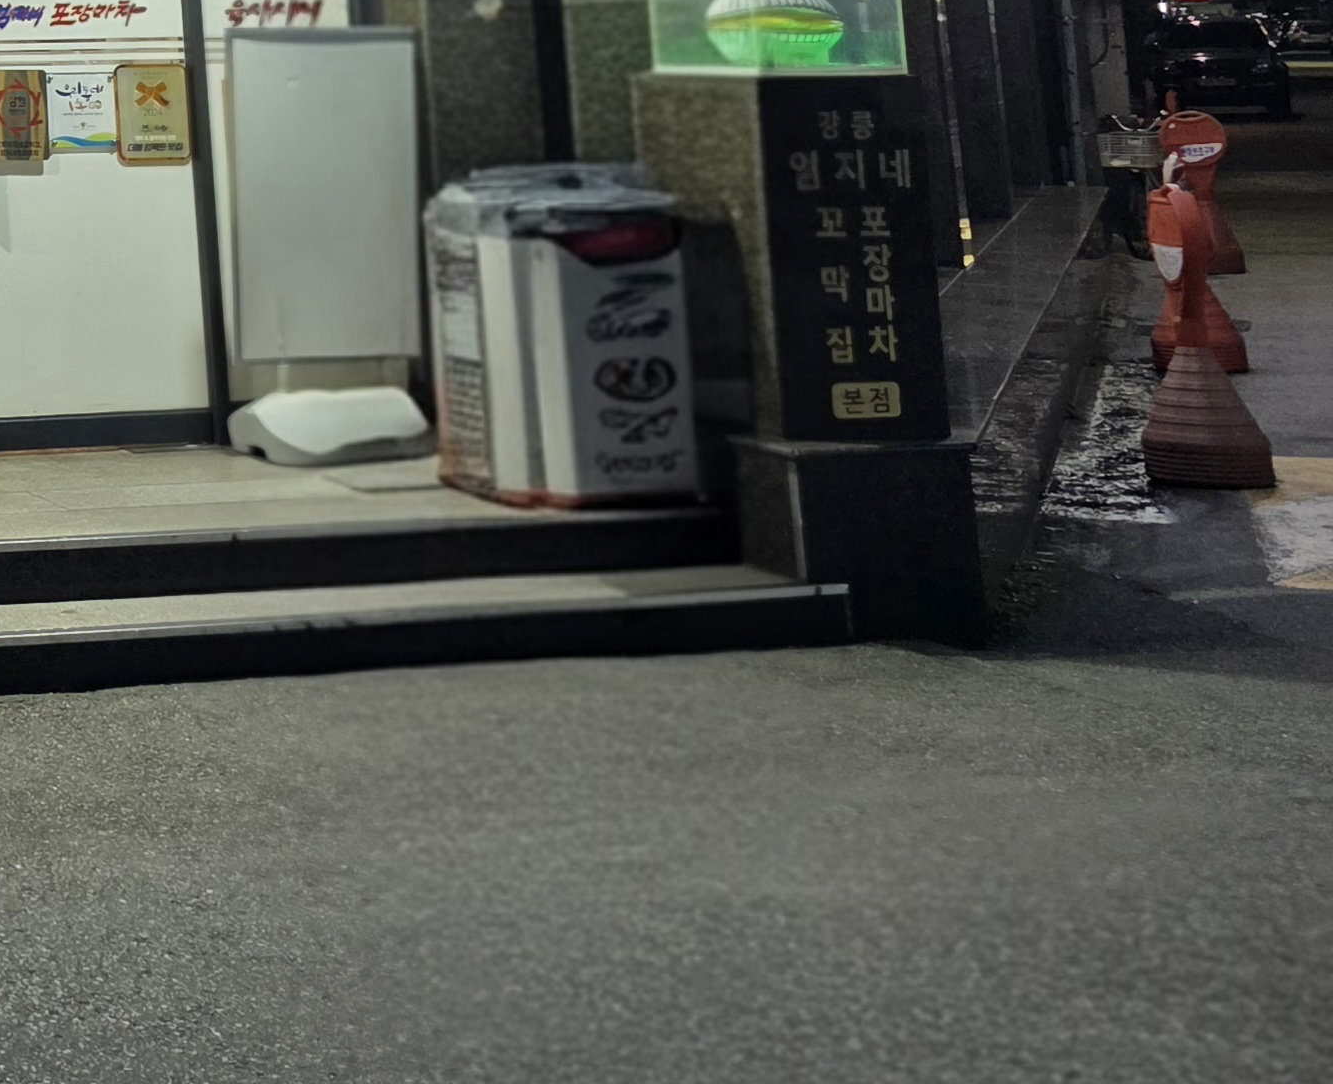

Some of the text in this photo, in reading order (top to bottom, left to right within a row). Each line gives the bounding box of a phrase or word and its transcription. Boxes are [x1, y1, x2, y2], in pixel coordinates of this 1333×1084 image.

[50, 0, 147, 28] 포장마차
[819, 110, 875, 140] 강릉
[789, 149, 912, 191] 엄지네
[859, 206, 899, 363] 포장마차
[841, 387, 891, 414] 본점
